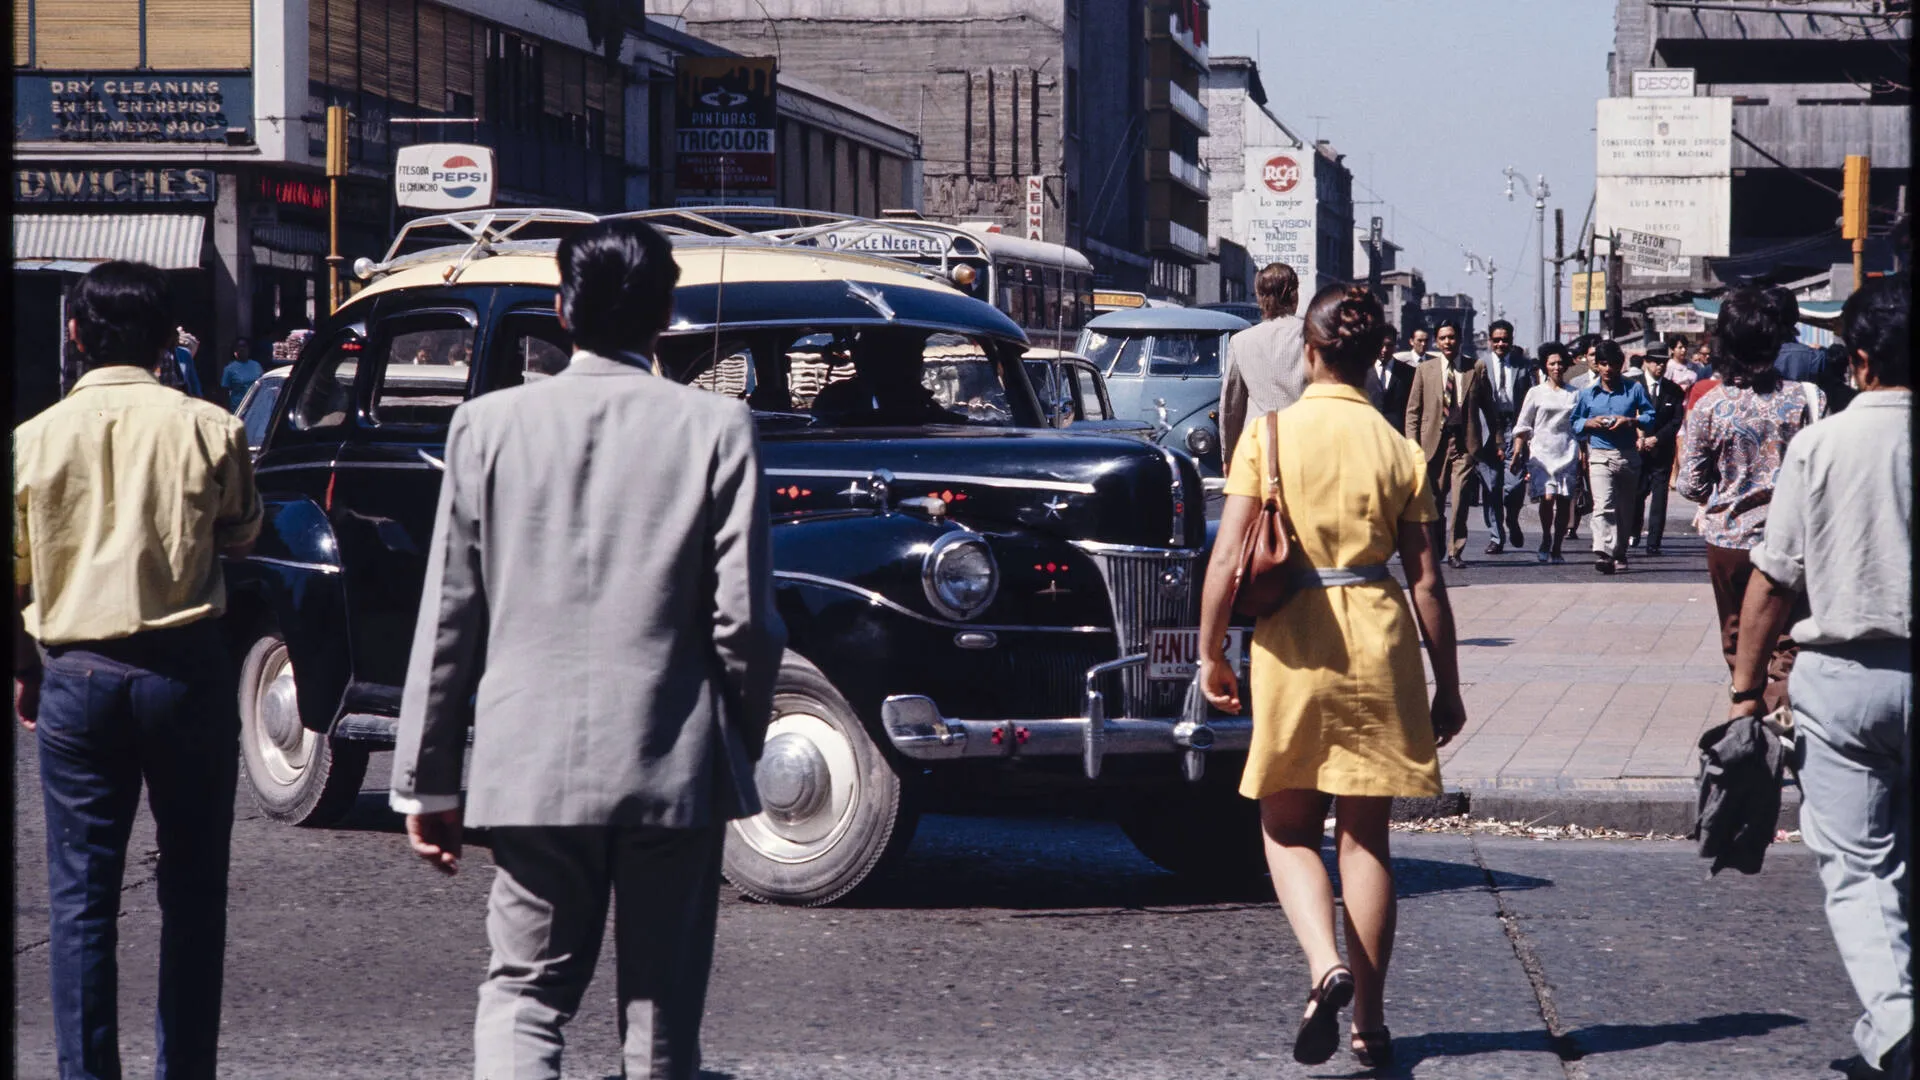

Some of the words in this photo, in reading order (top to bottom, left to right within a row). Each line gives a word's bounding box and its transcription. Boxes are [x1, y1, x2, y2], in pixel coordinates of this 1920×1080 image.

[51, 81, 95, 94] DRY
[103, 81, 219, 94] CLEANING
[1637, 77, 1690, 90] DESCO
[51, 101, 75, 113] EN
[86, 101, 107, 113] EL
[118, 101, 220, 113] ENTREPISO
[691, 112, 756, 126] PINTURAS
[64, 121, 160, 133] ALAMEDA
[678, 130, 769, 151] TRICOLOR
[432, 172, 488, 182] PEPSI
[1265, 166, 1298, 180] RCA
[19, 168, 208, 198] DWICHES
[1260, 196, 1272, 207] Lo
[1275, 196, 1303, 210] mejor
[1252, 219, 1312, 229] TELEVISION
[1265, 231, 1297, 241] RADIOS
[1631, 232, 1665, 249] PEATON
[1264, 243, 1297, 252] TUBOS
